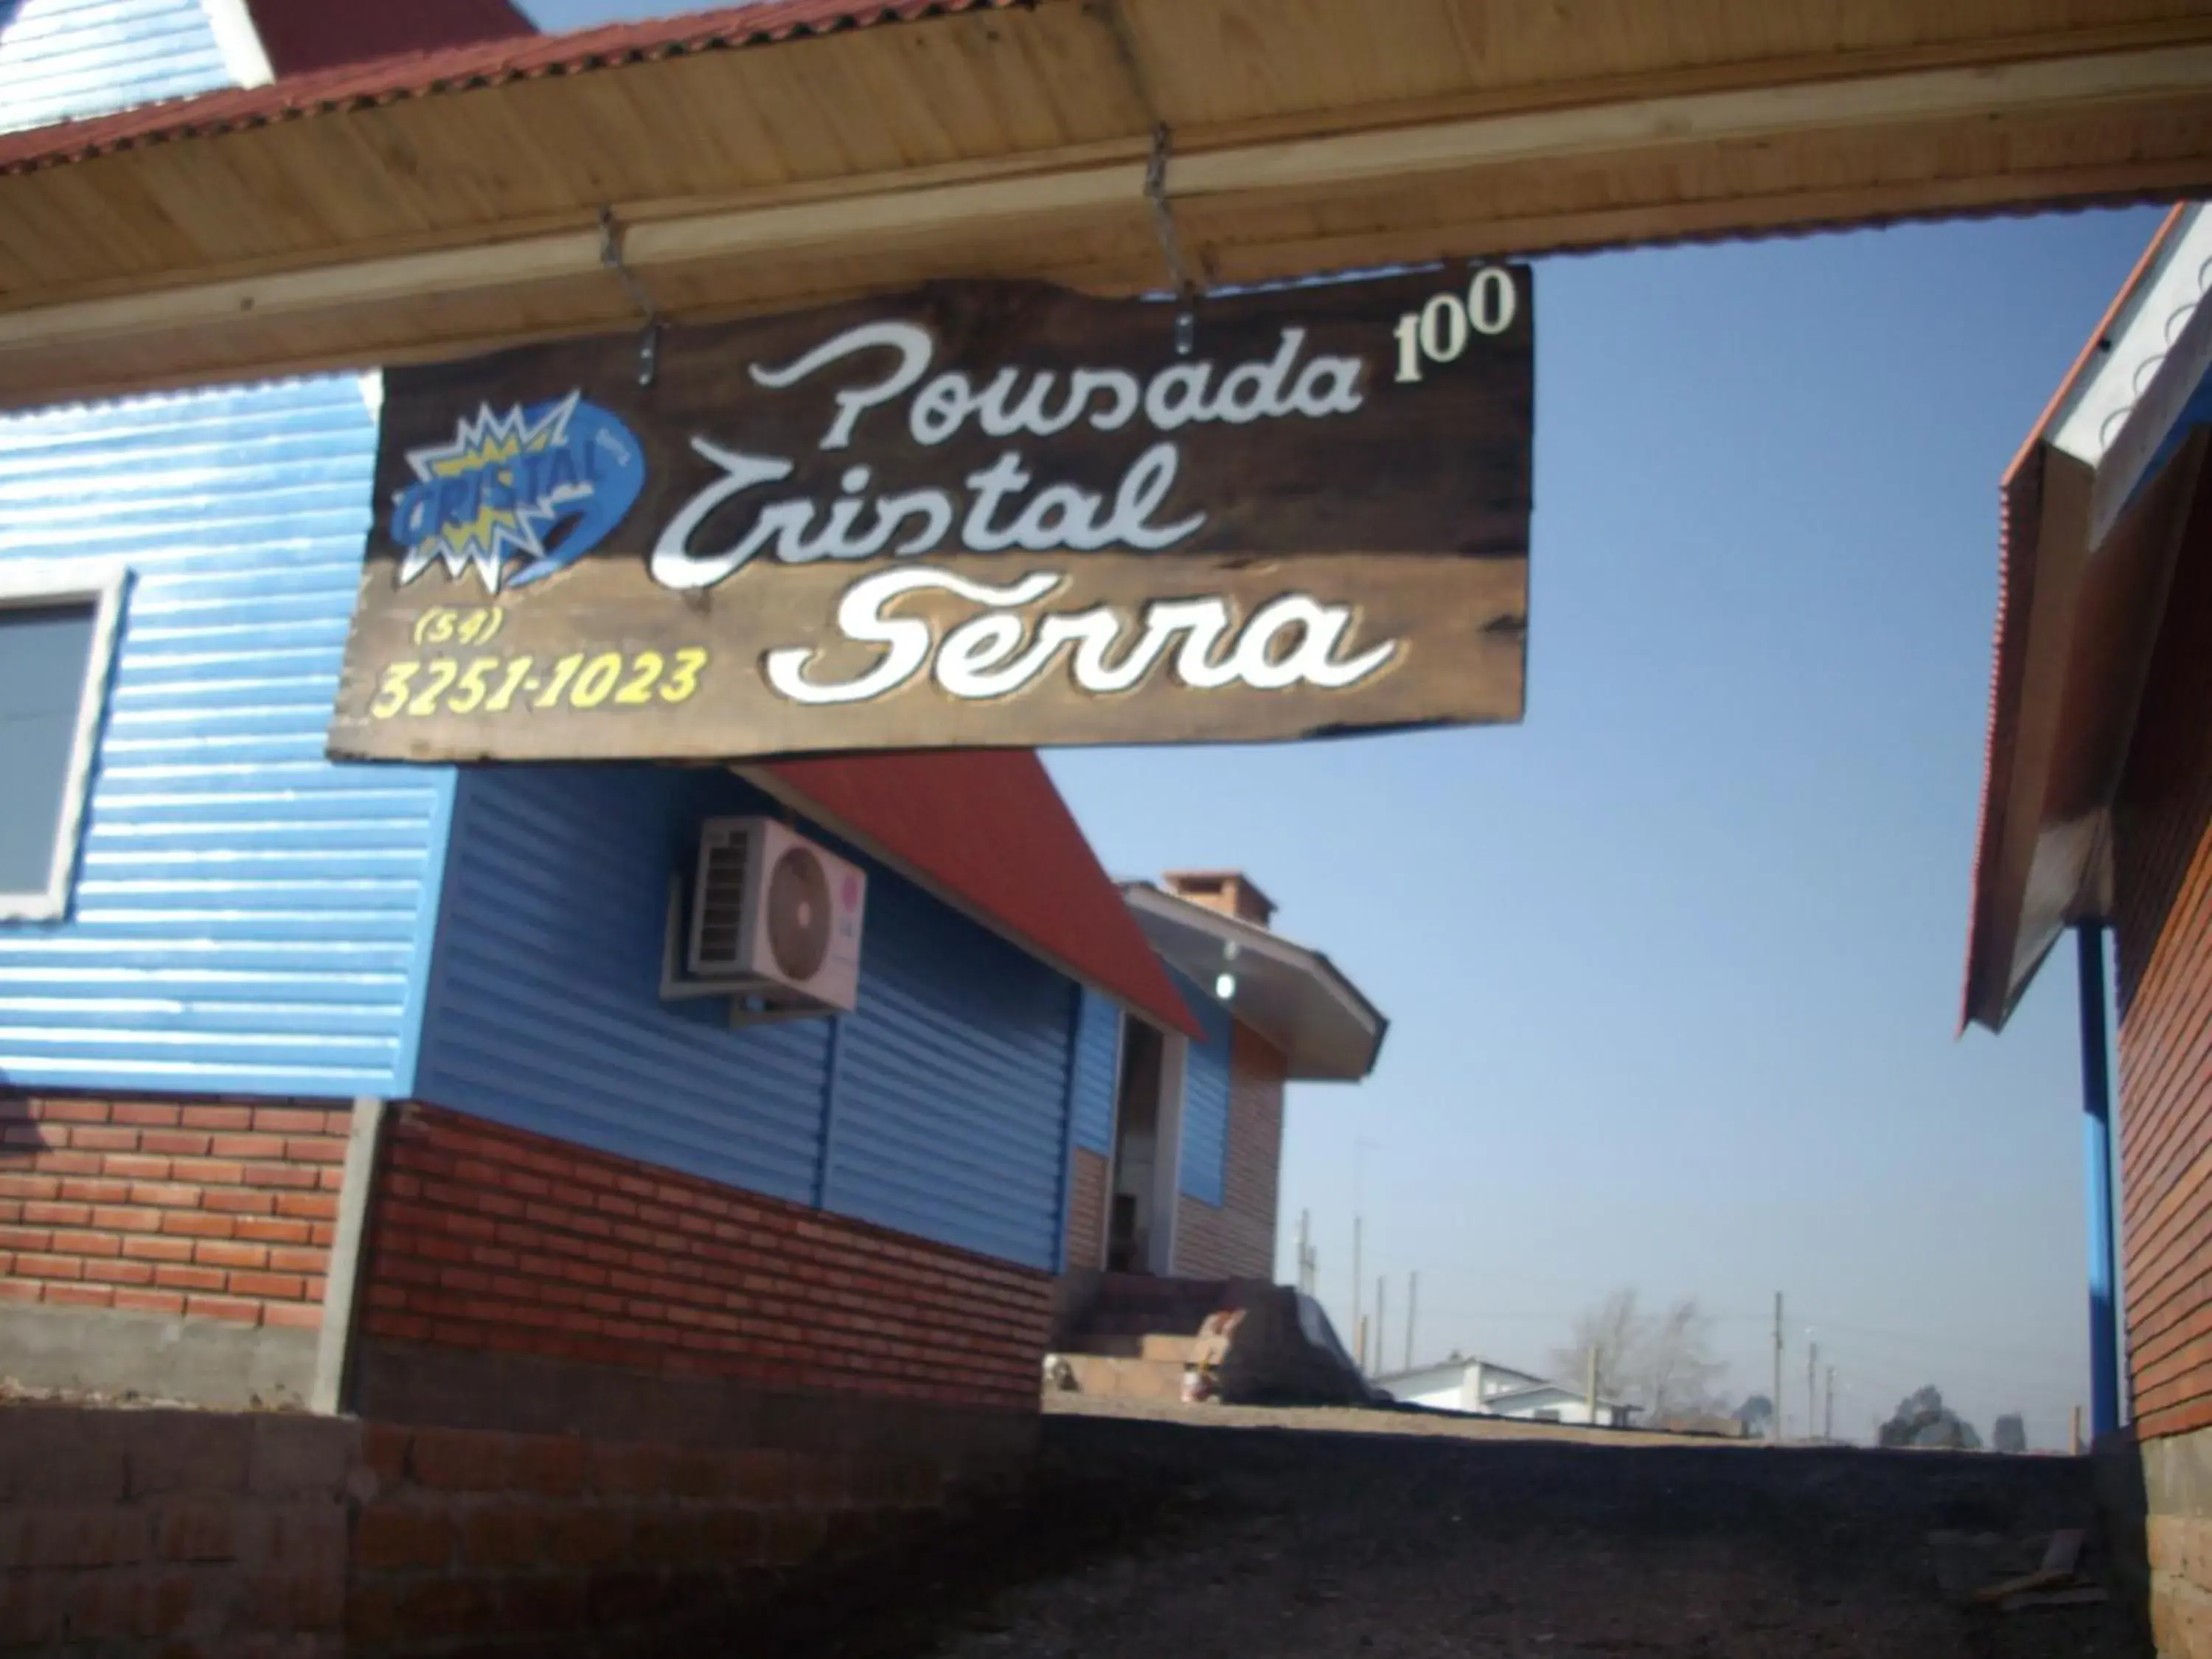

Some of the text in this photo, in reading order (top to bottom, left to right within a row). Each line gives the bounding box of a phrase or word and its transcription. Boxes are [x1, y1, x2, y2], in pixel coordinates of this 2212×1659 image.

[748, 322, 1366, 451] Pousada
[1392, 267, 1516, 384] 100
[649, 435, 1206, 590] Cristal
[372, 646, 709, 720] 3251-1023
[413, 606, 504, 646] (54)
[764, 564, 1391, 703] Serra
